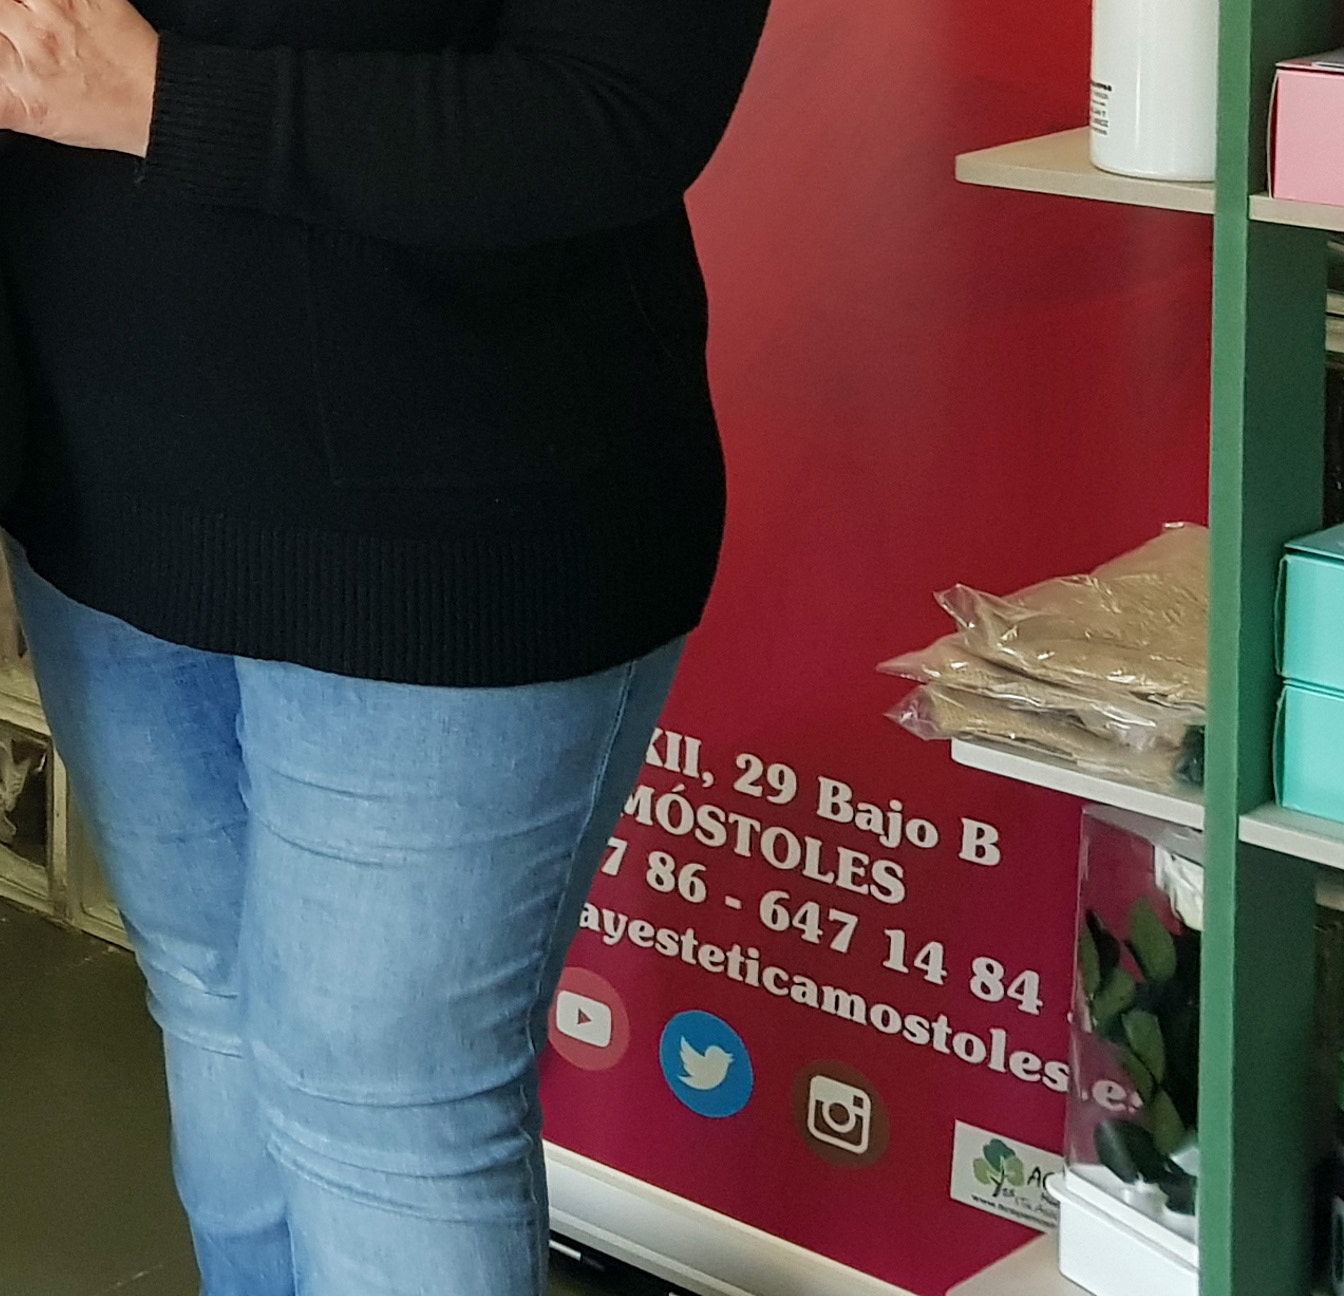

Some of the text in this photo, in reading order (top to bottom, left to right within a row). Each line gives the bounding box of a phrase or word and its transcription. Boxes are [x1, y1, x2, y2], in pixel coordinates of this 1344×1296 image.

[620, 783, 907, 904] MÓSTOLES
[733, 753, 797, 805] 29
[816, 776, 939, 850] Bajo
[959, 817, 1002, 867] B
[646, 851, 708, 904] 86
[759, 890, 859, 953] 647
[883, 928, 949, 985] 14
[970, 955, 1045, 1016] 84
